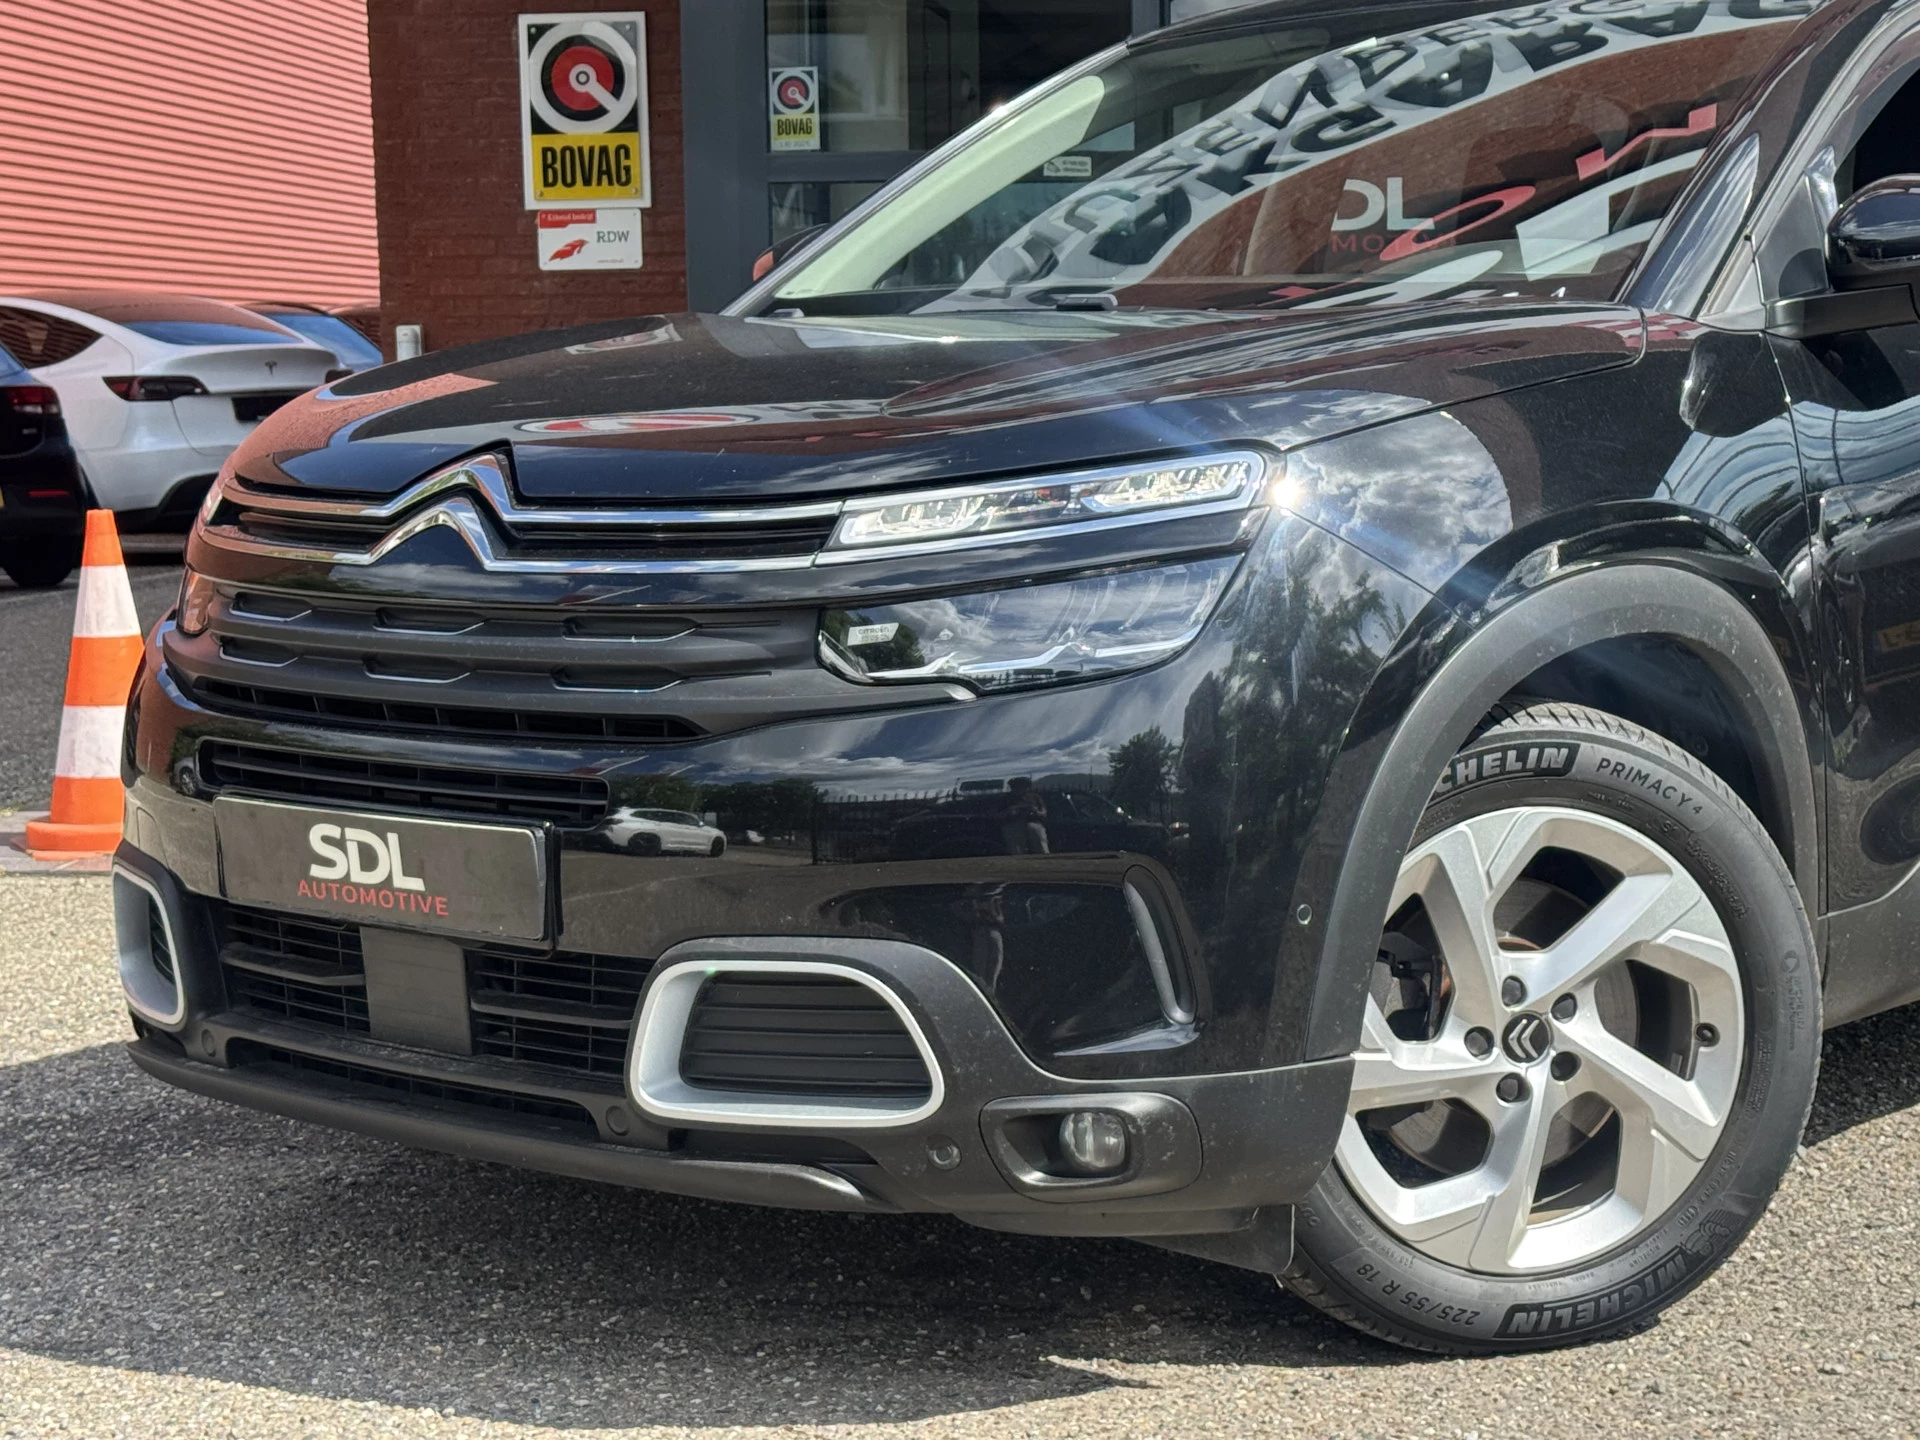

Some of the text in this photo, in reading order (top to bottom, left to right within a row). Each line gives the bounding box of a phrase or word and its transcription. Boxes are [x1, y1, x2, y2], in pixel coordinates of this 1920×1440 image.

[777, 117, 813, 136] BOVAG
[541, 143, 632, 188] BOVAG
[597, 230, 630, 243] RDW
[1596, 757, 1693, 807] PRIMACY
[1692, 805, 1703, 814] 4
[309, 823, 425, 891] SDL
[297, 879, 449, 916] AUTOMOTIVE
[1356, 1263, 1481, 1326] 225/55 R 18
[1506, 1253, 1687, 1334] MICHELIN
